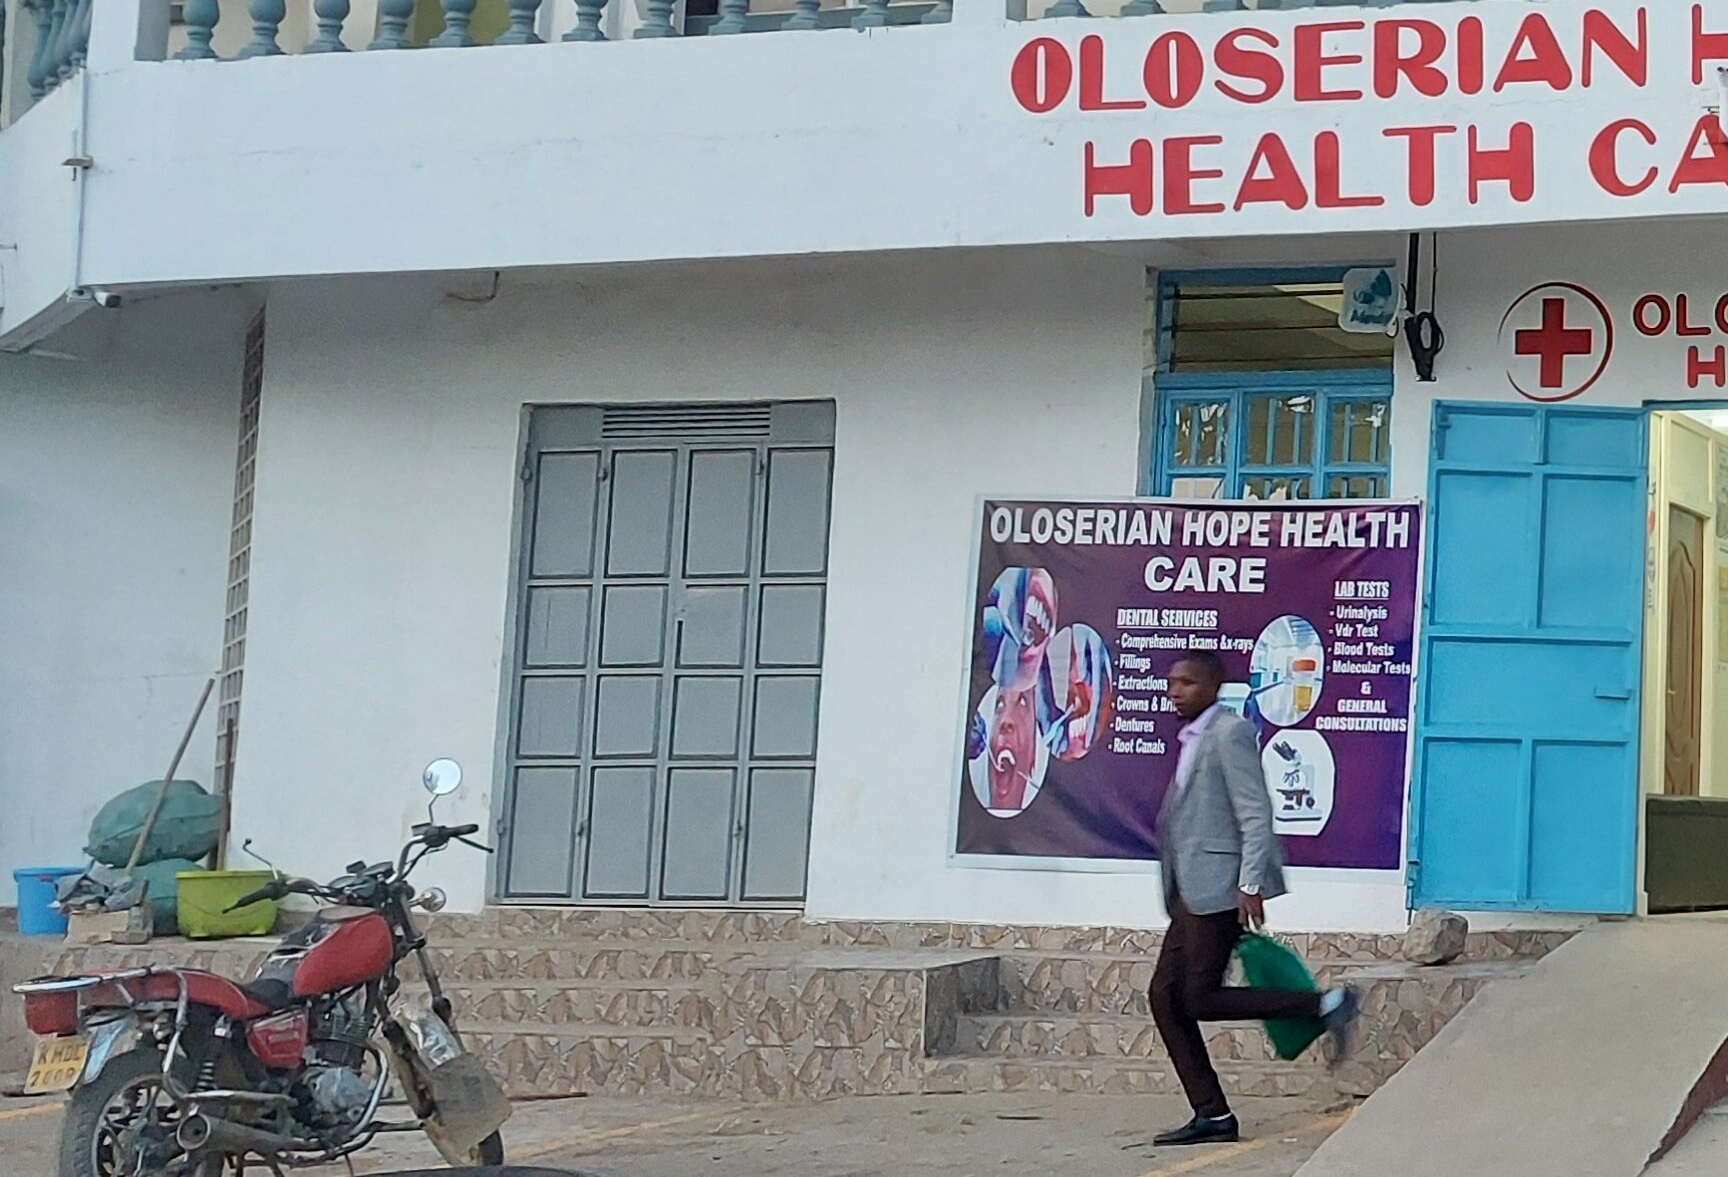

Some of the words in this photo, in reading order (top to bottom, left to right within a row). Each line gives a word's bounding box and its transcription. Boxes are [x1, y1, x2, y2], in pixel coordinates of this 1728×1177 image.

[1011, 6, 1647, 114] OLOSERIAN
[1085, 121, 1535, 217] HEALTH
[990, 507, 1172, 546] OLOSERIAN
[1182, 510, 1270, 548] HOPE
[1280, 511, 1410, 549] HEALTH
[1144, 556, 1267, 593] CARE
[1334, 581, 1355, 598] LAB
[1357, 581, 1390, 599] TESTS
[1117, 608, 1159, 626] DENTAL
[1161, 609, 1218, 627] SERVICES
[1336, 605, 1388, 623] Urinalysis
[1334, 624, 1354, 638] Vdr
[1356, 623, 1379, 638] Test
[1121, 633, 1187, 651] Comprehensive
[1188, 634, 1218, 650] Exams
[1333, 642, 1364, 656] Blood
[1365, 643, 1395, 657] Tests
[1119, 654, 1151, 672] Fillings
[1332, 660, 1382, 674] Molecular
[1383, 661, 1411, 675] Tests
[1118, 675, 1168, 692] Extractions
[1360, 681, 1372, 695] &
[1117, 695, 1149, 712] Crowns
[1151, 696, 1158, 712] &
[1337, 699, 1388, 714] GENERAL
[1115, 717, 1155, 733] Dentures
[1315, 716, 1408, 732] CONSULTATIONS
[1113, 738, 1134, 753] Root
[1135, 738, 1166, 754] Canals
